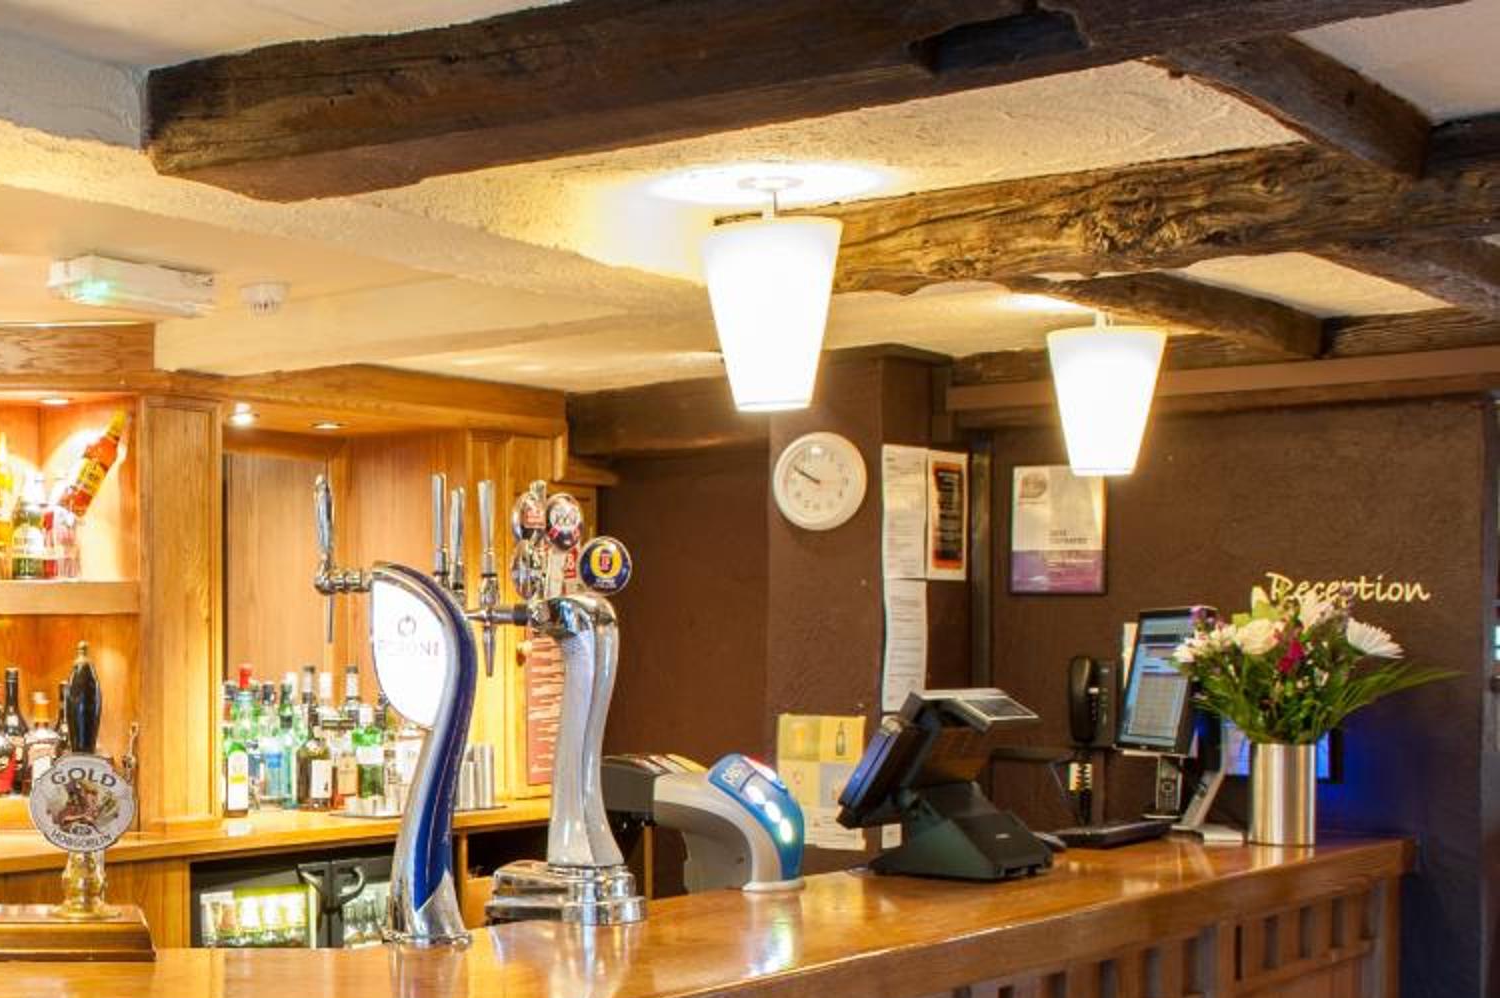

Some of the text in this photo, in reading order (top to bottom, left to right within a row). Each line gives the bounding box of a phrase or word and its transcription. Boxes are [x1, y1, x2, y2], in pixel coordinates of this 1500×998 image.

[1266, 572, 1431, 607] Reception
[377, 639, 439, 656] PONI
[51, 767, 117, 787] GOLD
